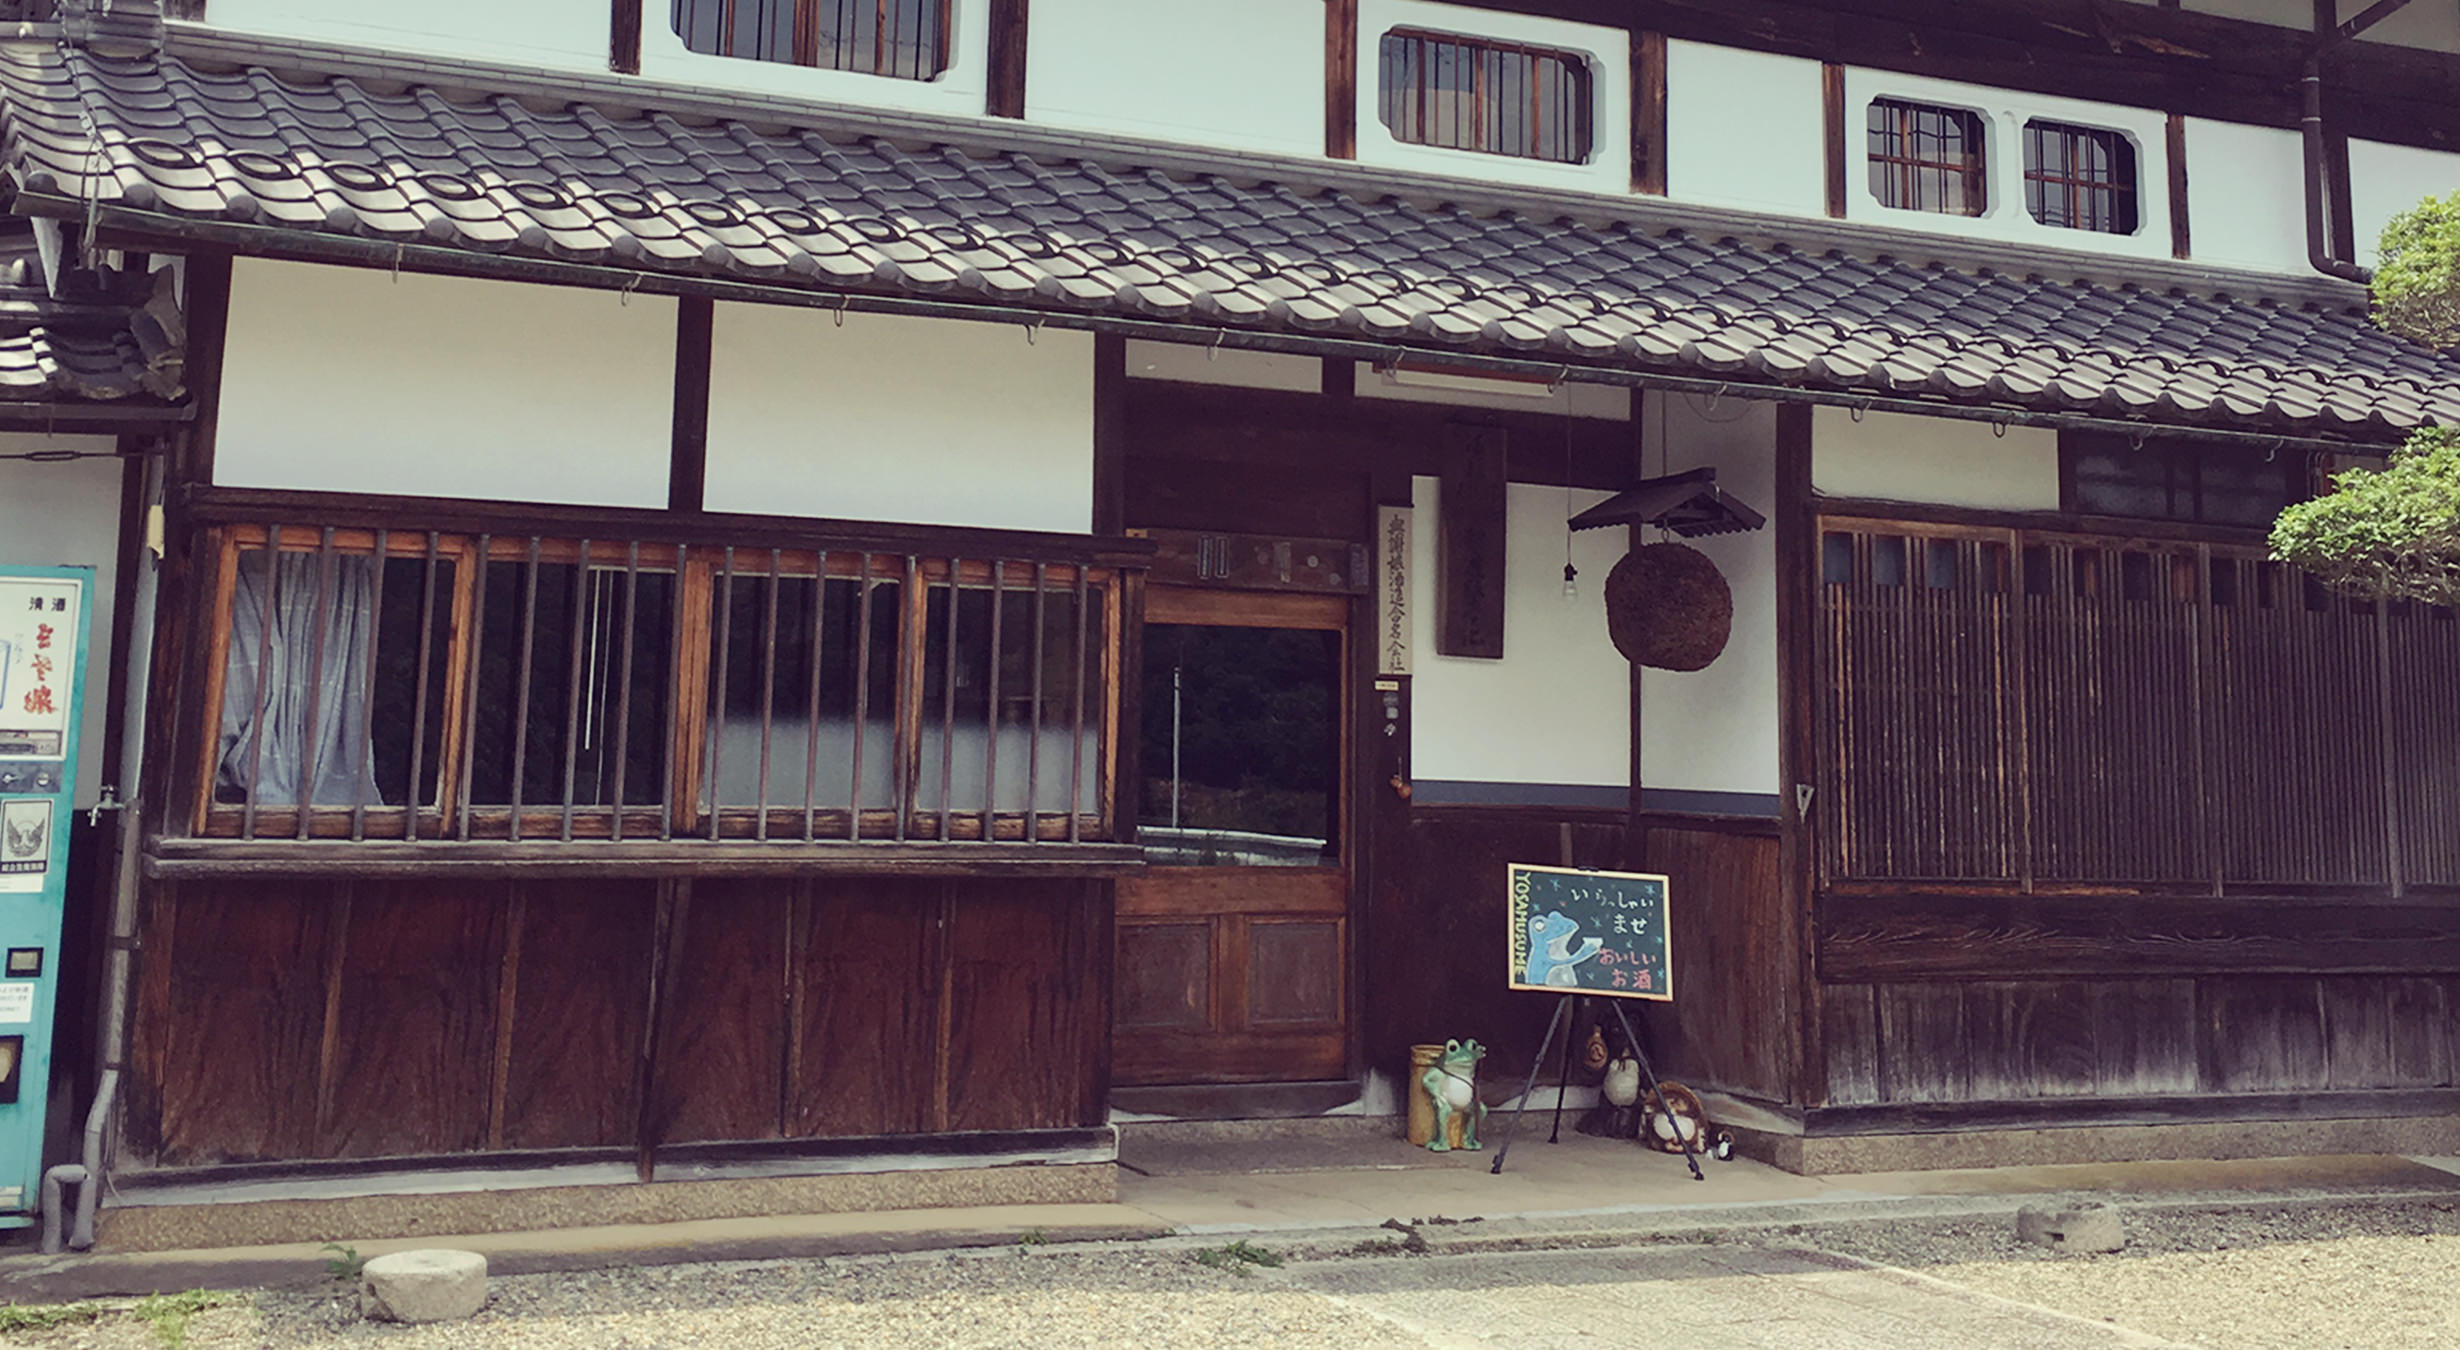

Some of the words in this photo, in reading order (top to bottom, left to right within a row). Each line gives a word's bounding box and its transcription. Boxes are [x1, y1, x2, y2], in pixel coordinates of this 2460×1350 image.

[1570, 887, 1655, 910] いらっしゃい
[1514, 870, 1531, 977] YOSAMUSUME
[1613, 914, 1648, 935] ませ
[1599, 948, 1657, 966] おいしい
[1611, 969, 1653, 990] お酒
